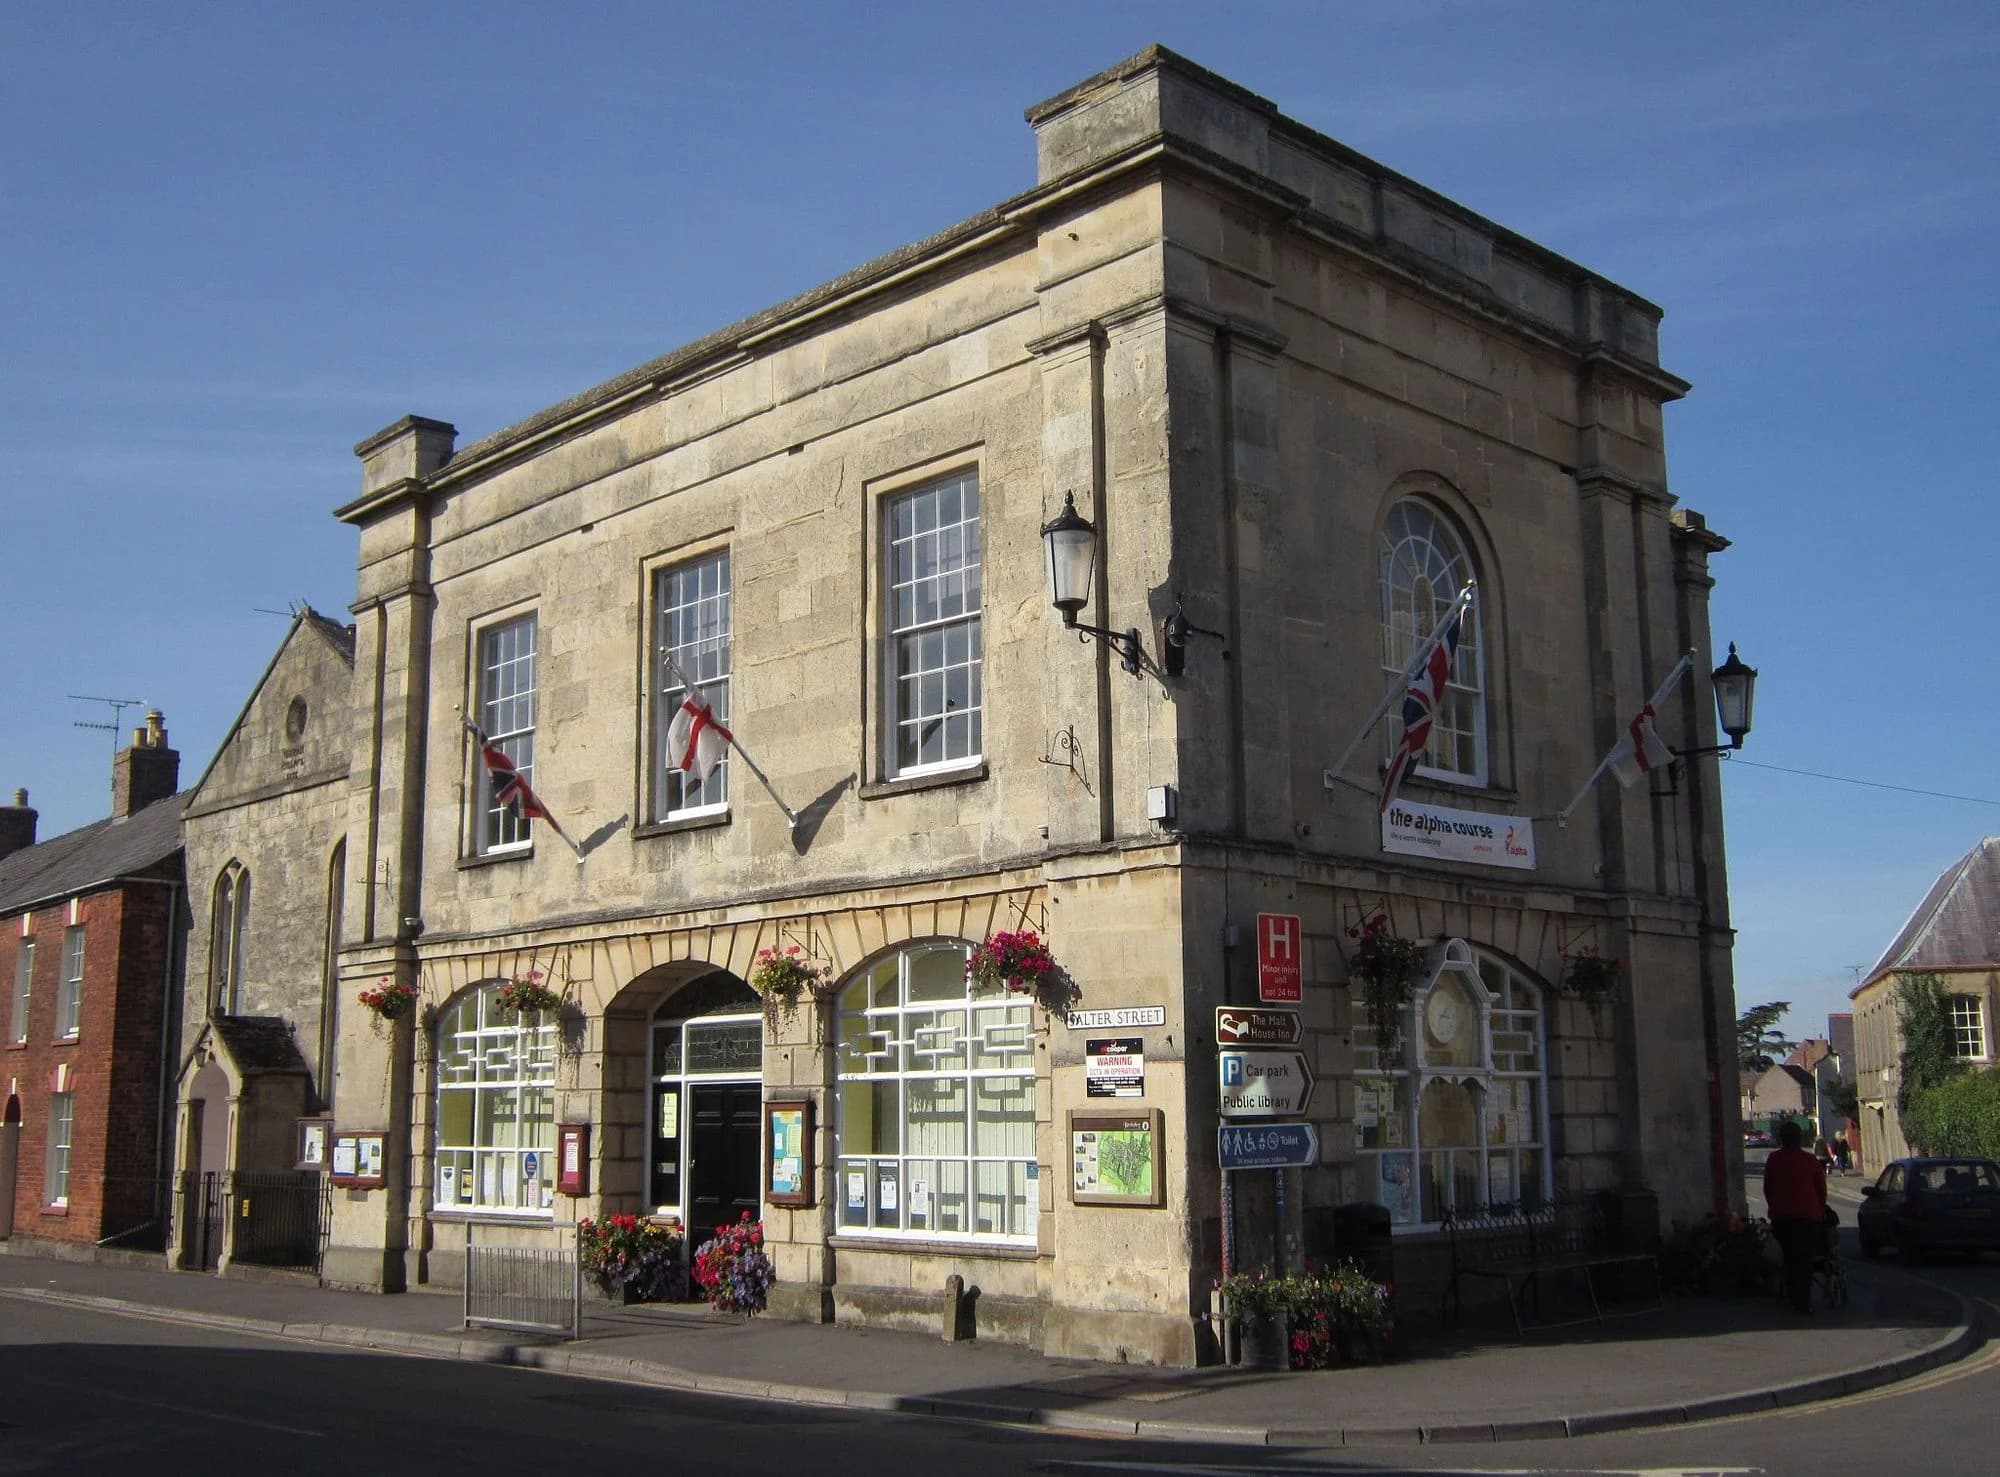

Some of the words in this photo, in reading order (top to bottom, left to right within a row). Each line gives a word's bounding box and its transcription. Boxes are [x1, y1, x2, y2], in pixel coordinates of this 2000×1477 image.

[1390, 808, 1413, 828] the
[1414, 813, 1452, 835] alpha
[1453, 822, 1494, 839] course
[1269, 919, 1291, 959] H
[1262, 964, 1280, 974] Minor
[1281, 965, 1299, 976] injury
[1277, 988, 1286, 997] 24
[1287, 988, 1297, 997] hrs
[1069, 1013, 1112, 1026] SALTER
[1117, 1010, 1161, 1024] STREET
[1251, 1014, 1266, 1025] The
[1269, 1015, 1286, 1026] Malt
[1251, 1028, 1276, 1039] House
[1278, 1029, 1290, 1040] Inn
[1097, 1056, 1132, 1067] WARNING
[1111, 1067, 1141, 1075] OPERATION
[1228, 1059, 1240, 1084] P
[1246, 1064, 1263, 1077] Car
[1267, 1064, 1289, 1080] park
[1223, 1095, 1255, 1108] Public
[1258, 1095, 1290, 1110] library
